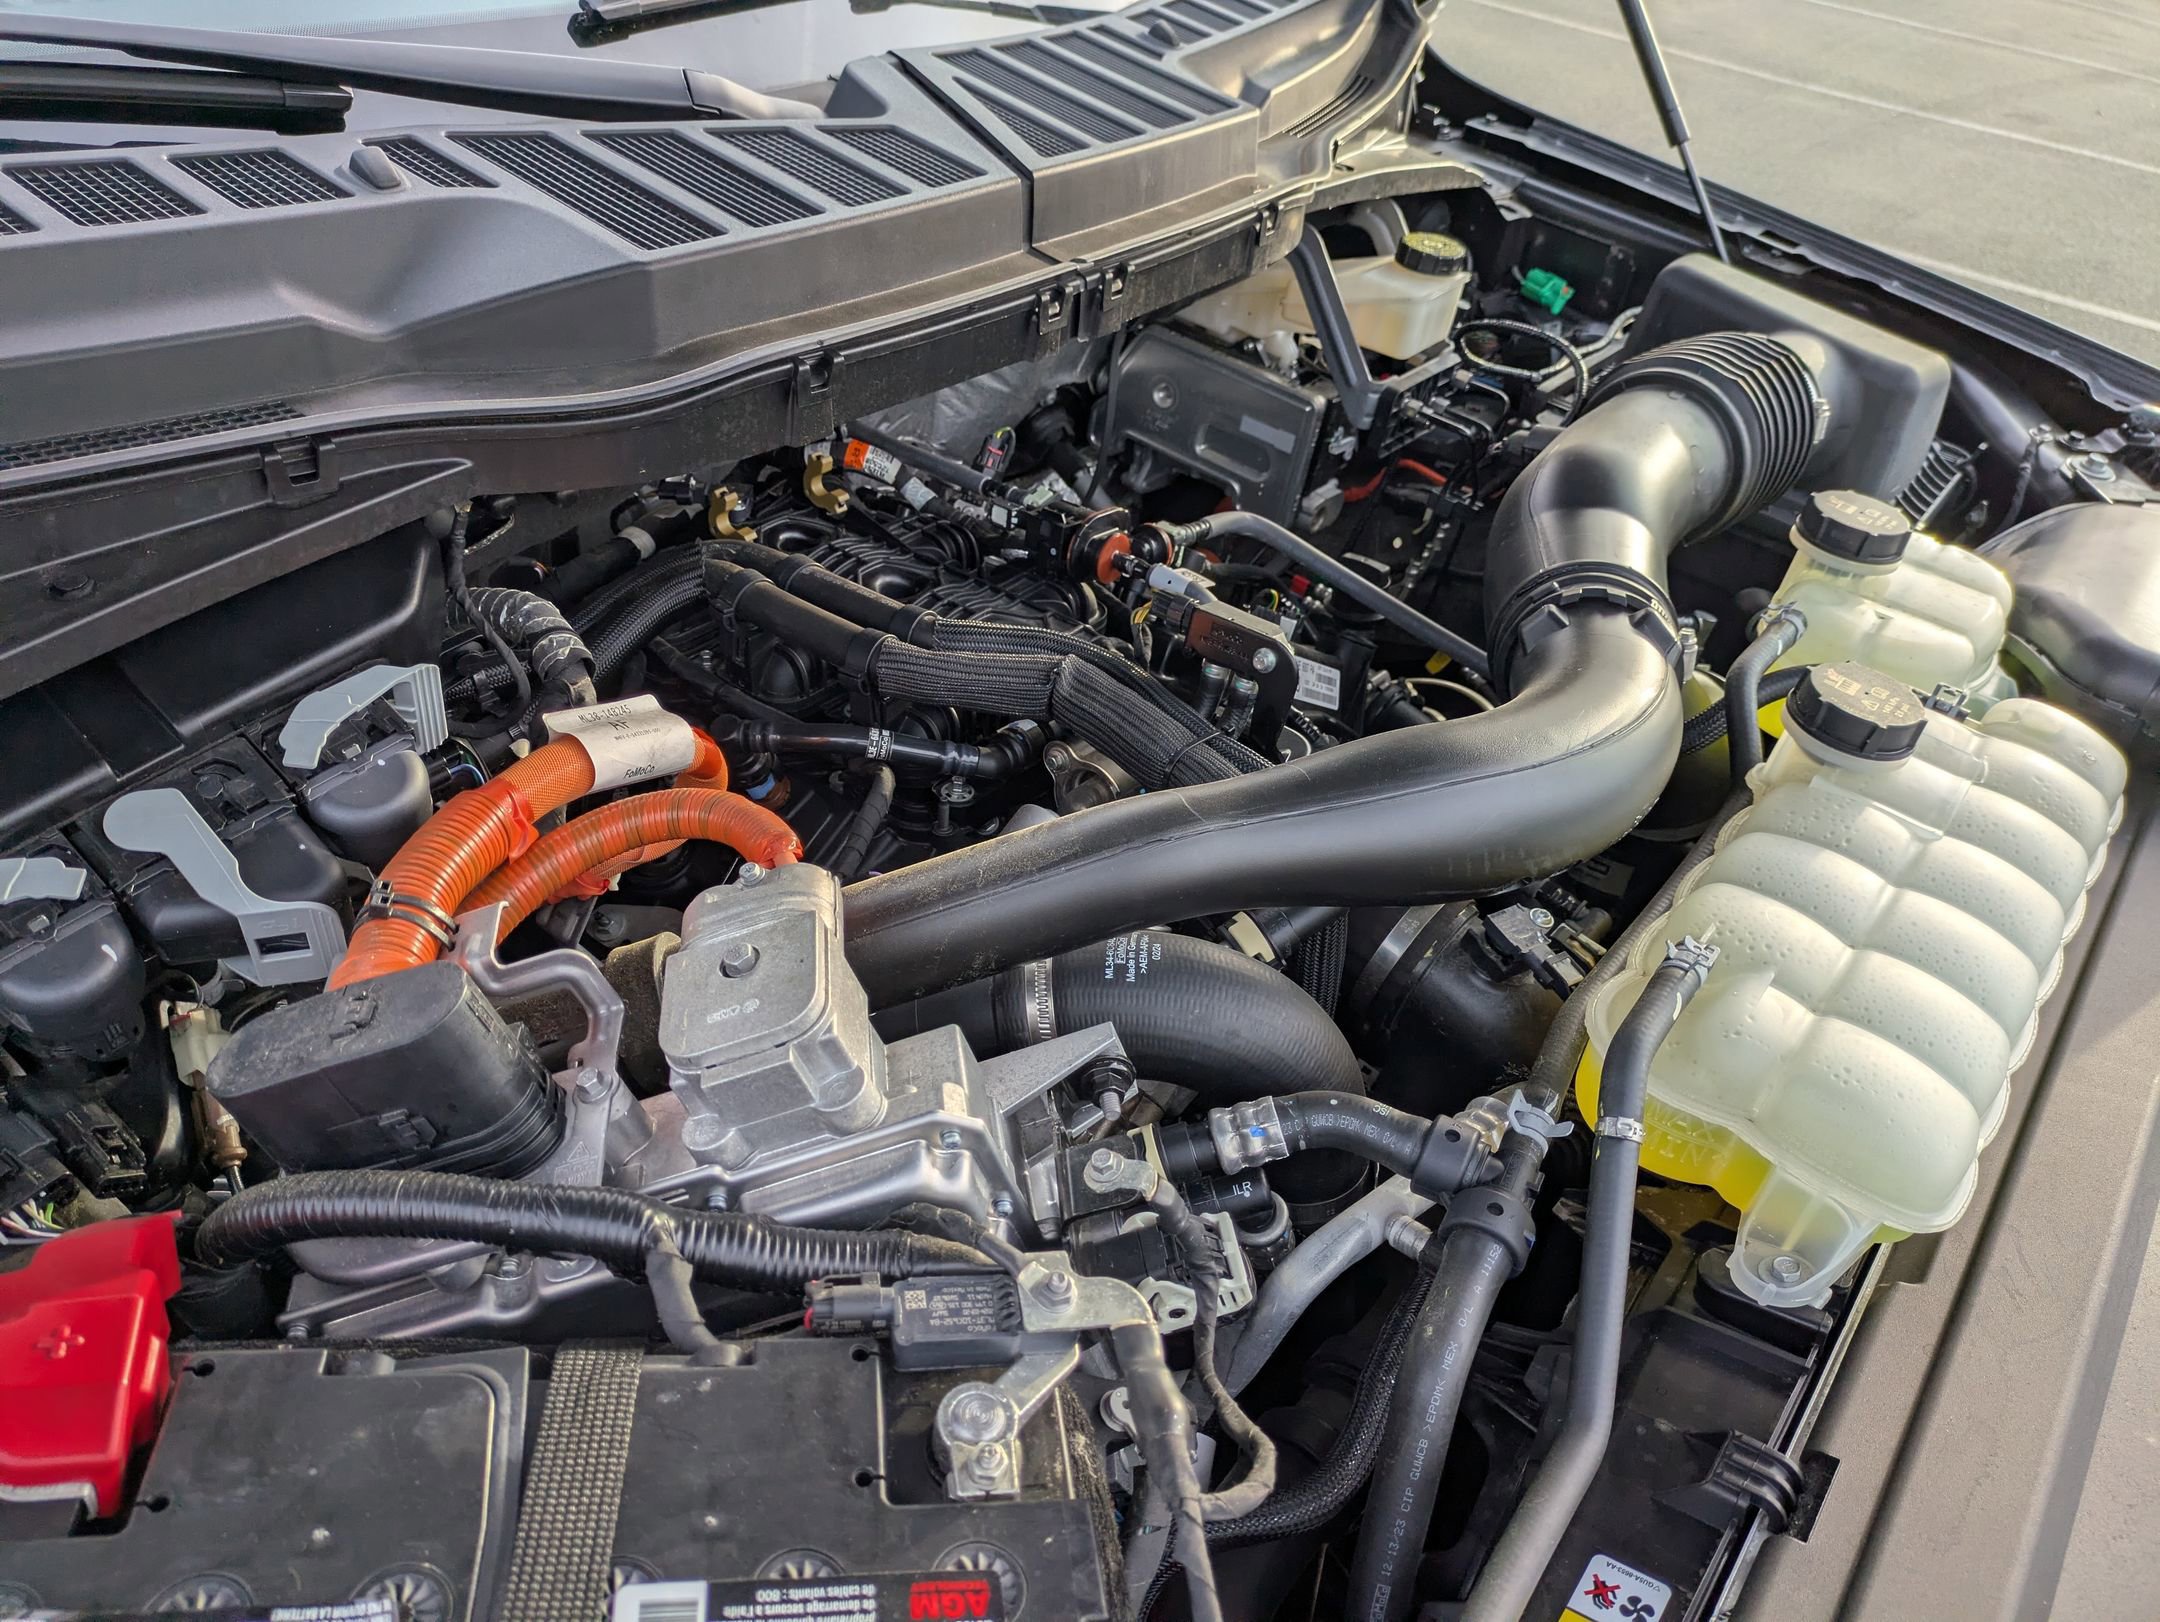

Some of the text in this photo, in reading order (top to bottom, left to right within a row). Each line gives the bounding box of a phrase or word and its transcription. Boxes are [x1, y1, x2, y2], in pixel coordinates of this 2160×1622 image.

[578, 704, 632, 724] ML38-14B245
[623, 764, 655, 779] FoMoCo
[1152, 943, 1161, 960] 02/24
[1126, 959, 1136, 982] Made
[1232, 1181, 1253, 1196] ILR
[1423, 1377, 1448, 1433] >EPDM<
[1442, 1341, 1459, 1371] MEX
[910, 1592, 991, 1620] AGM
